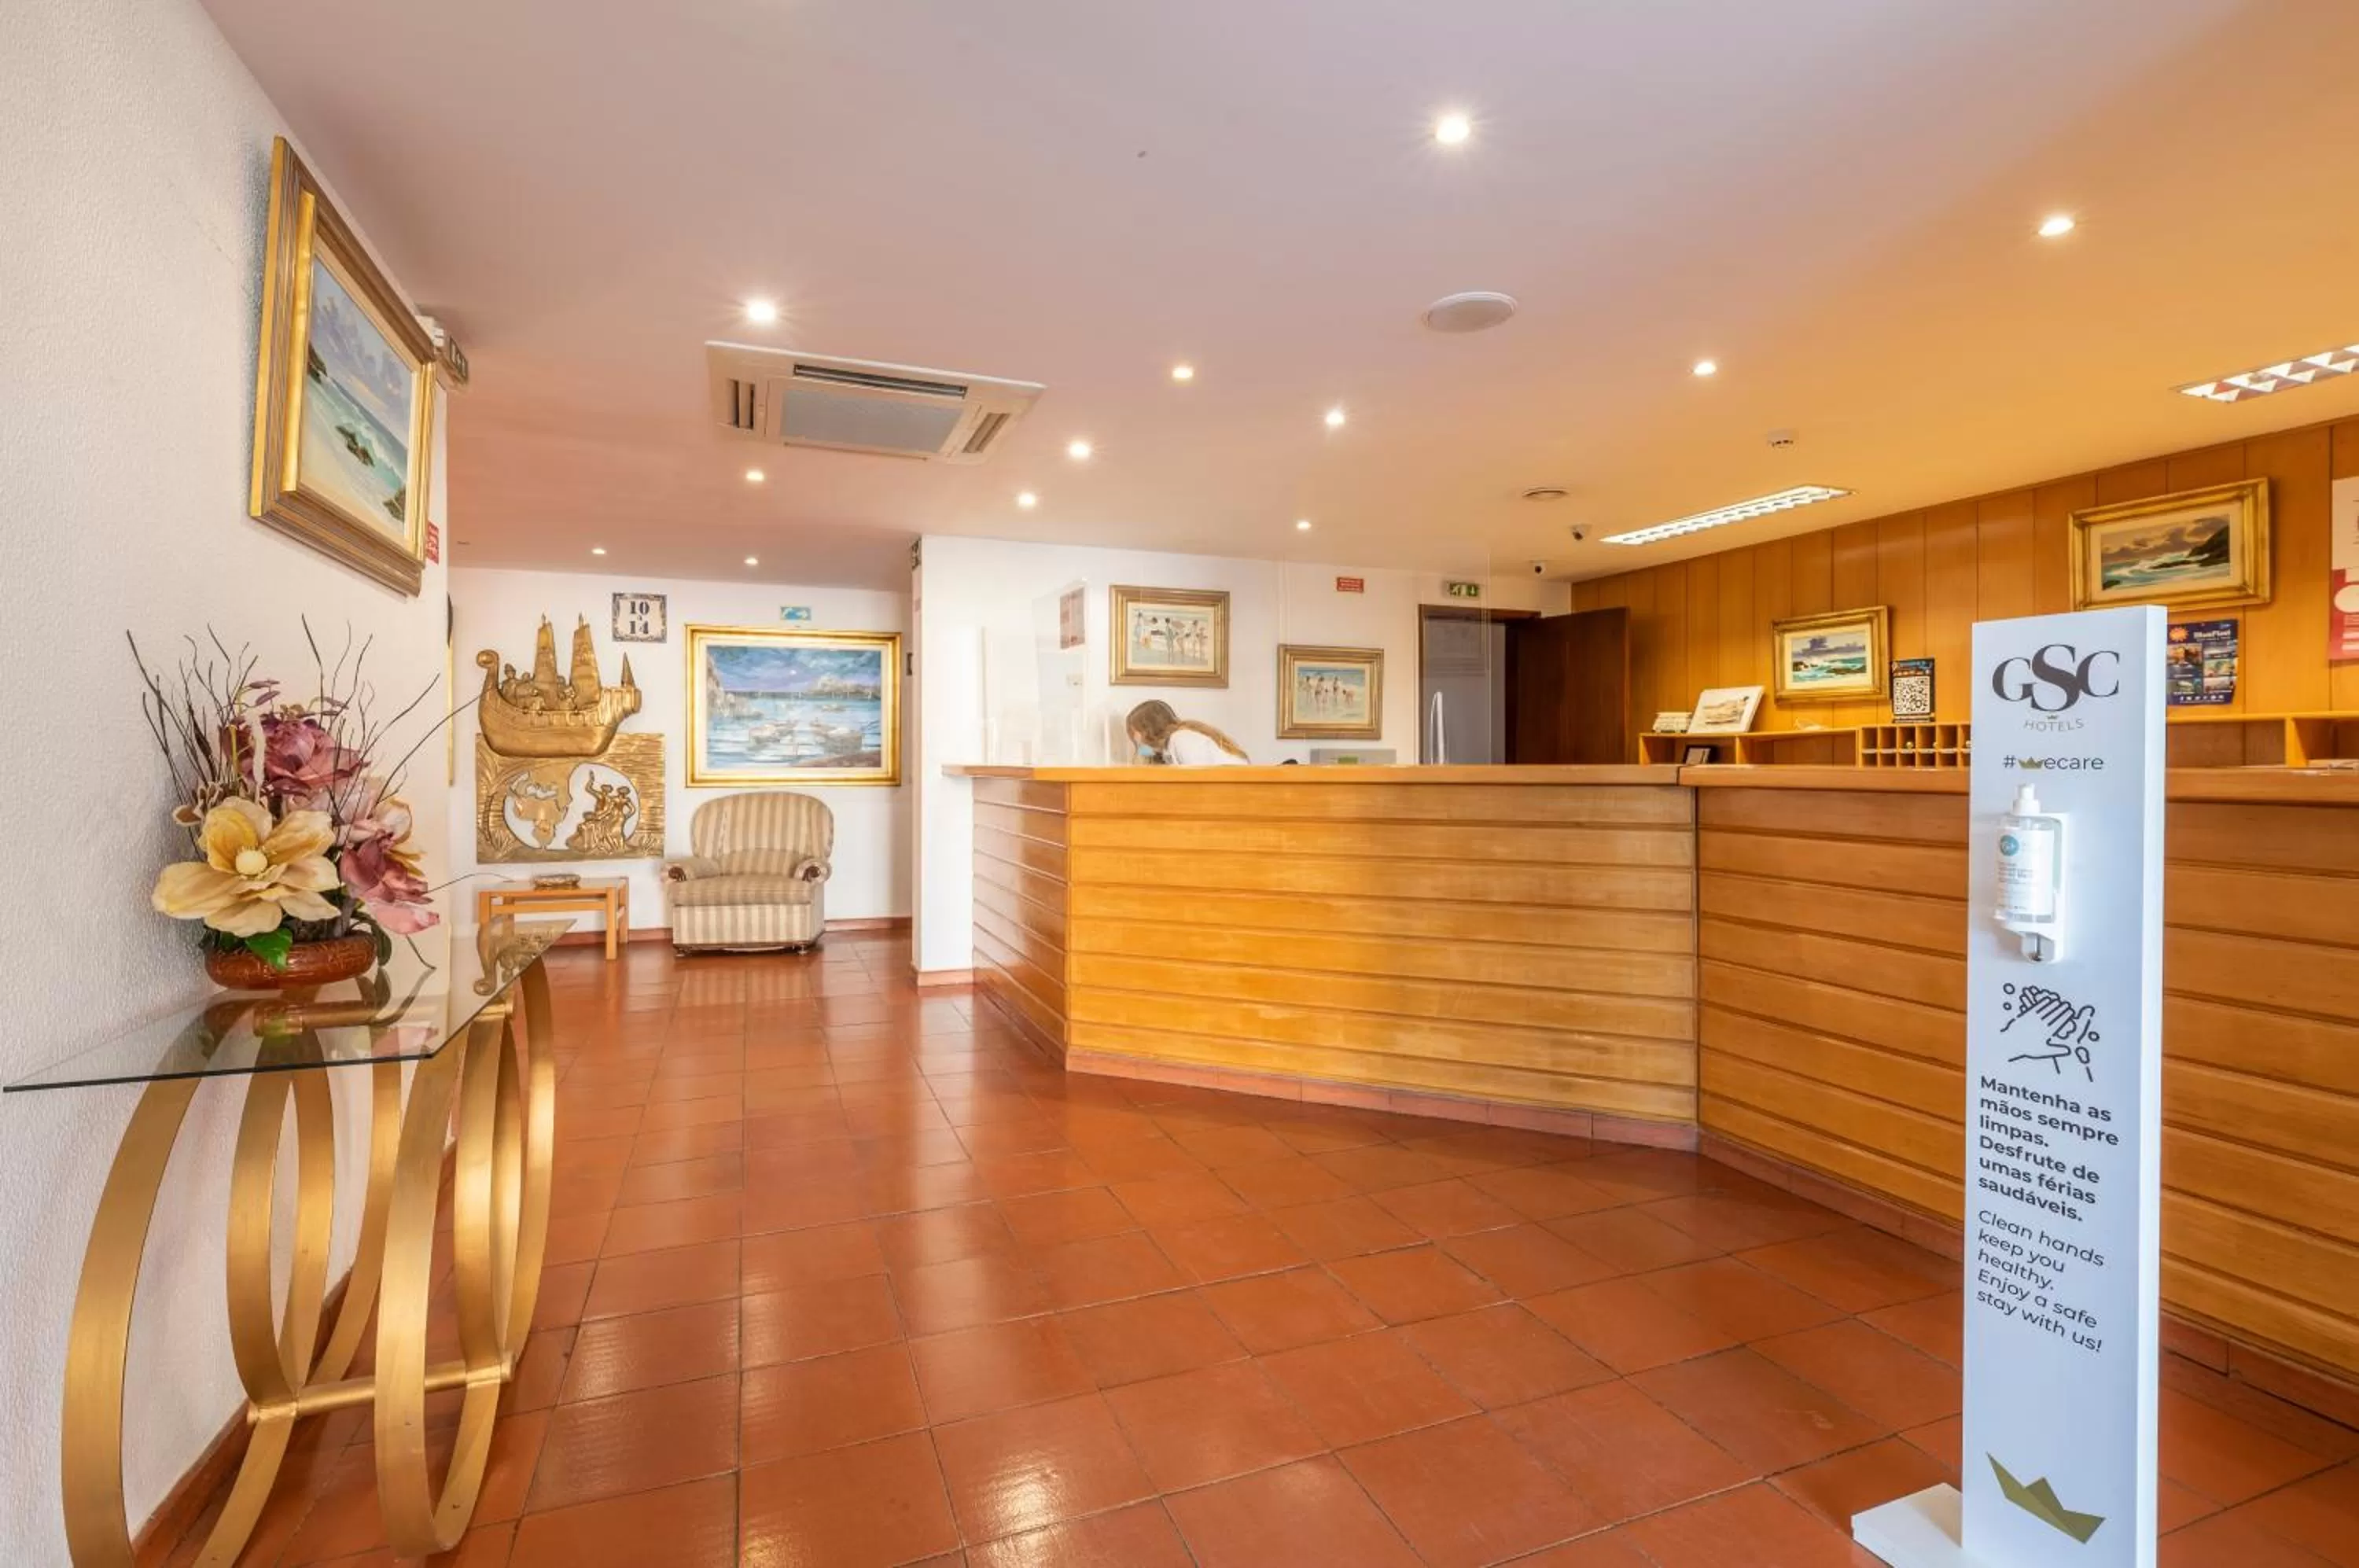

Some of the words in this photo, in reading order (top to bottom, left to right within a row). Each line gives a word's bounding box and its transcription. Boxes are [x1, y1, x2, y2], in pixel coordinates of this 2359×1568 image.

[630, 601, 650, 614] 10
[630, 620, 649, 634] 14
[1992, 644, 2120, 712] GSC
[2023, 719, 2085, 731] HOTELS
[1982, 1076, 2080, 1113] Mantenha
[2088, 1107, 2111, 1121] as
[1980, 1115, 2048, 1147] limpas.
[1981, 1098, 2032, 1121] mãos
[2038, 1115, 2118, 1145] sempre
[1980, 1136, 2066, 1173] Desfrute
[2073, 1165, 2100, 1183] de
[1980, 1158, 2032, 1183] umas
[2038, 1173, 2096, 1204] férias
[1978, 1177, 2082, 1221] saudáveis.
[1978, 1228, 2023, 1257] keep
[2027, 1251, 2064, 1272] you
[1979, 1210, 2032, 1239] Clean
[2039, 1231, 2104, 1266] hands
[1978, 1249, 2053, 1290] healthy.
[1978, 1269, 2030, 1301] Enjoy
[2035, 1296, 2047, 1307] a
[2053, 1304, 2096, 1327] safe
[1978, 1291, 2017, 1316] stay
[2022, 1309, 2065, 1337] with
[2073, 1332, 2101, 1352] us!
